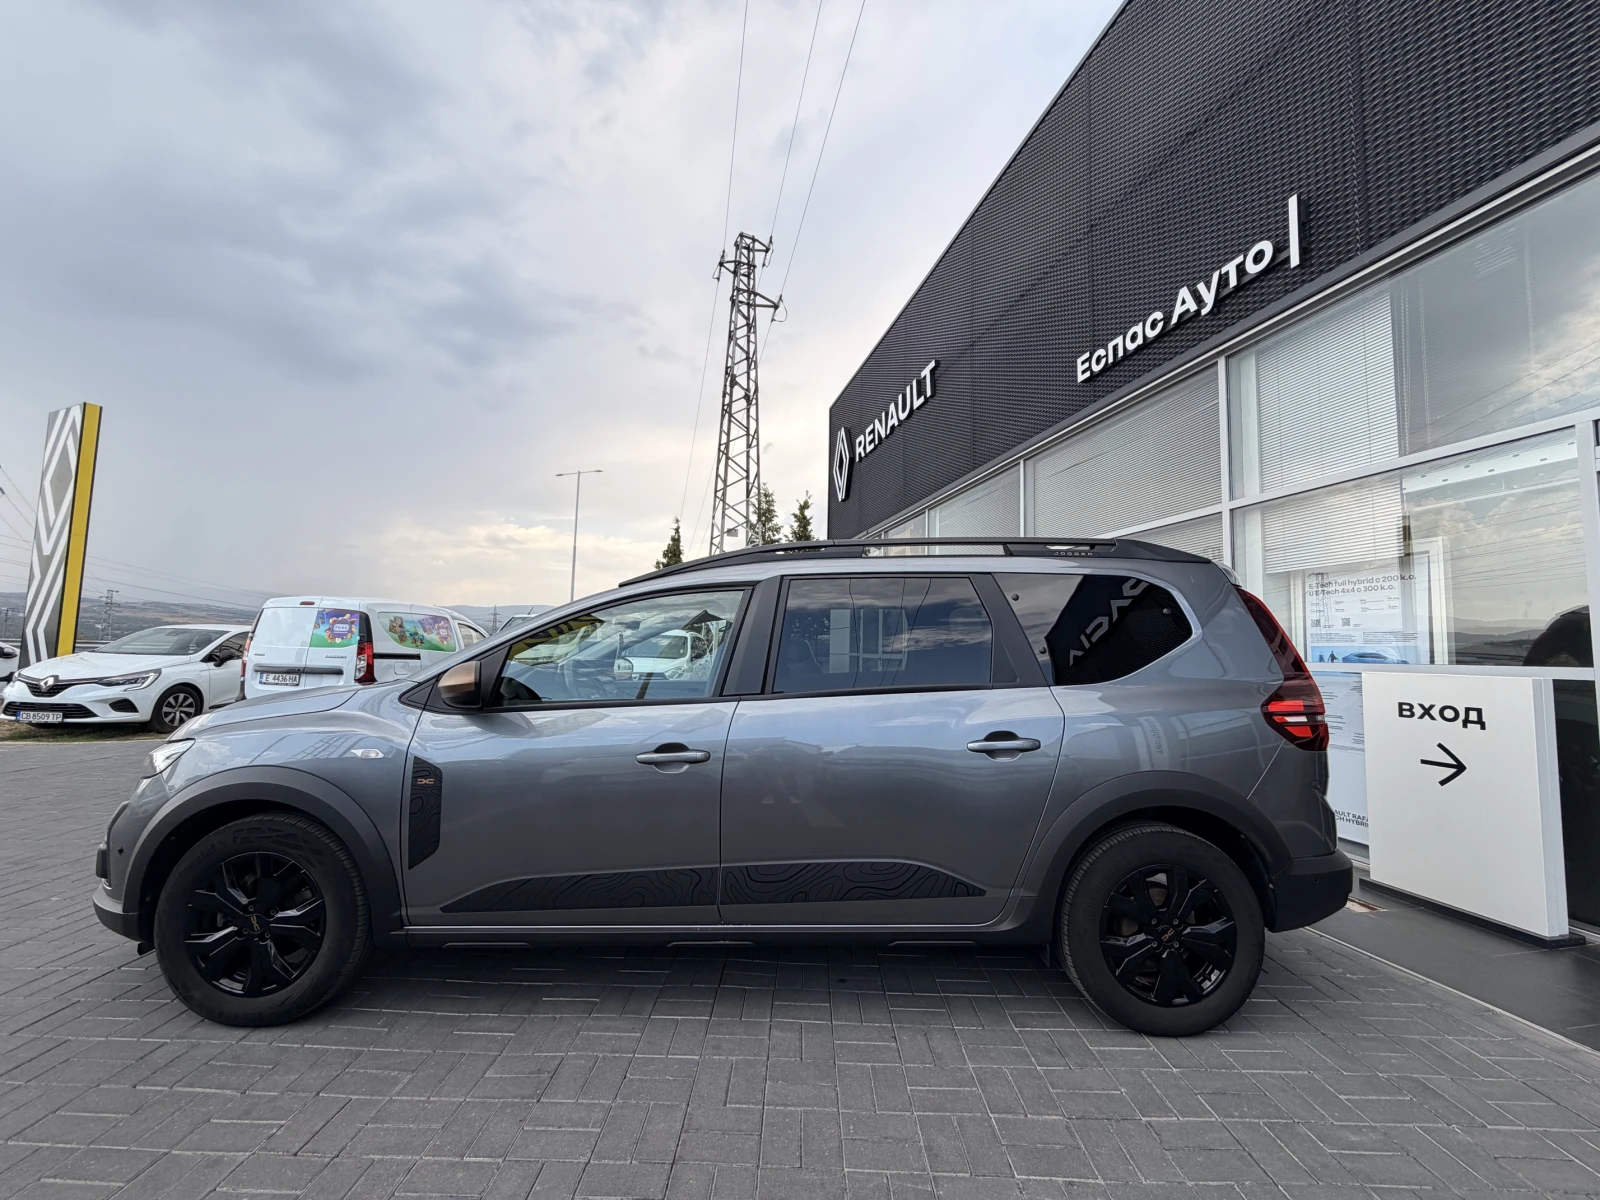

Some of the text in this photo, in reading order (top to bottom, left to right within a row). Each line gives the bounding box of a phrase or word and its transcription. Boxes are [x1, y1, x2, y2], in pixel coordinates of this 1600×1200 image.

[1076, 240, 1274, 383] Еспас Ауто
[855, 359, 936, 462] RENAULT
[1348, 577, 1374, 587] hybrid
[1382, 575, 1399, 583] 200
[272, 674, 288, 683] 4436
[21, 712, 62, 721] CB 8509 TP
